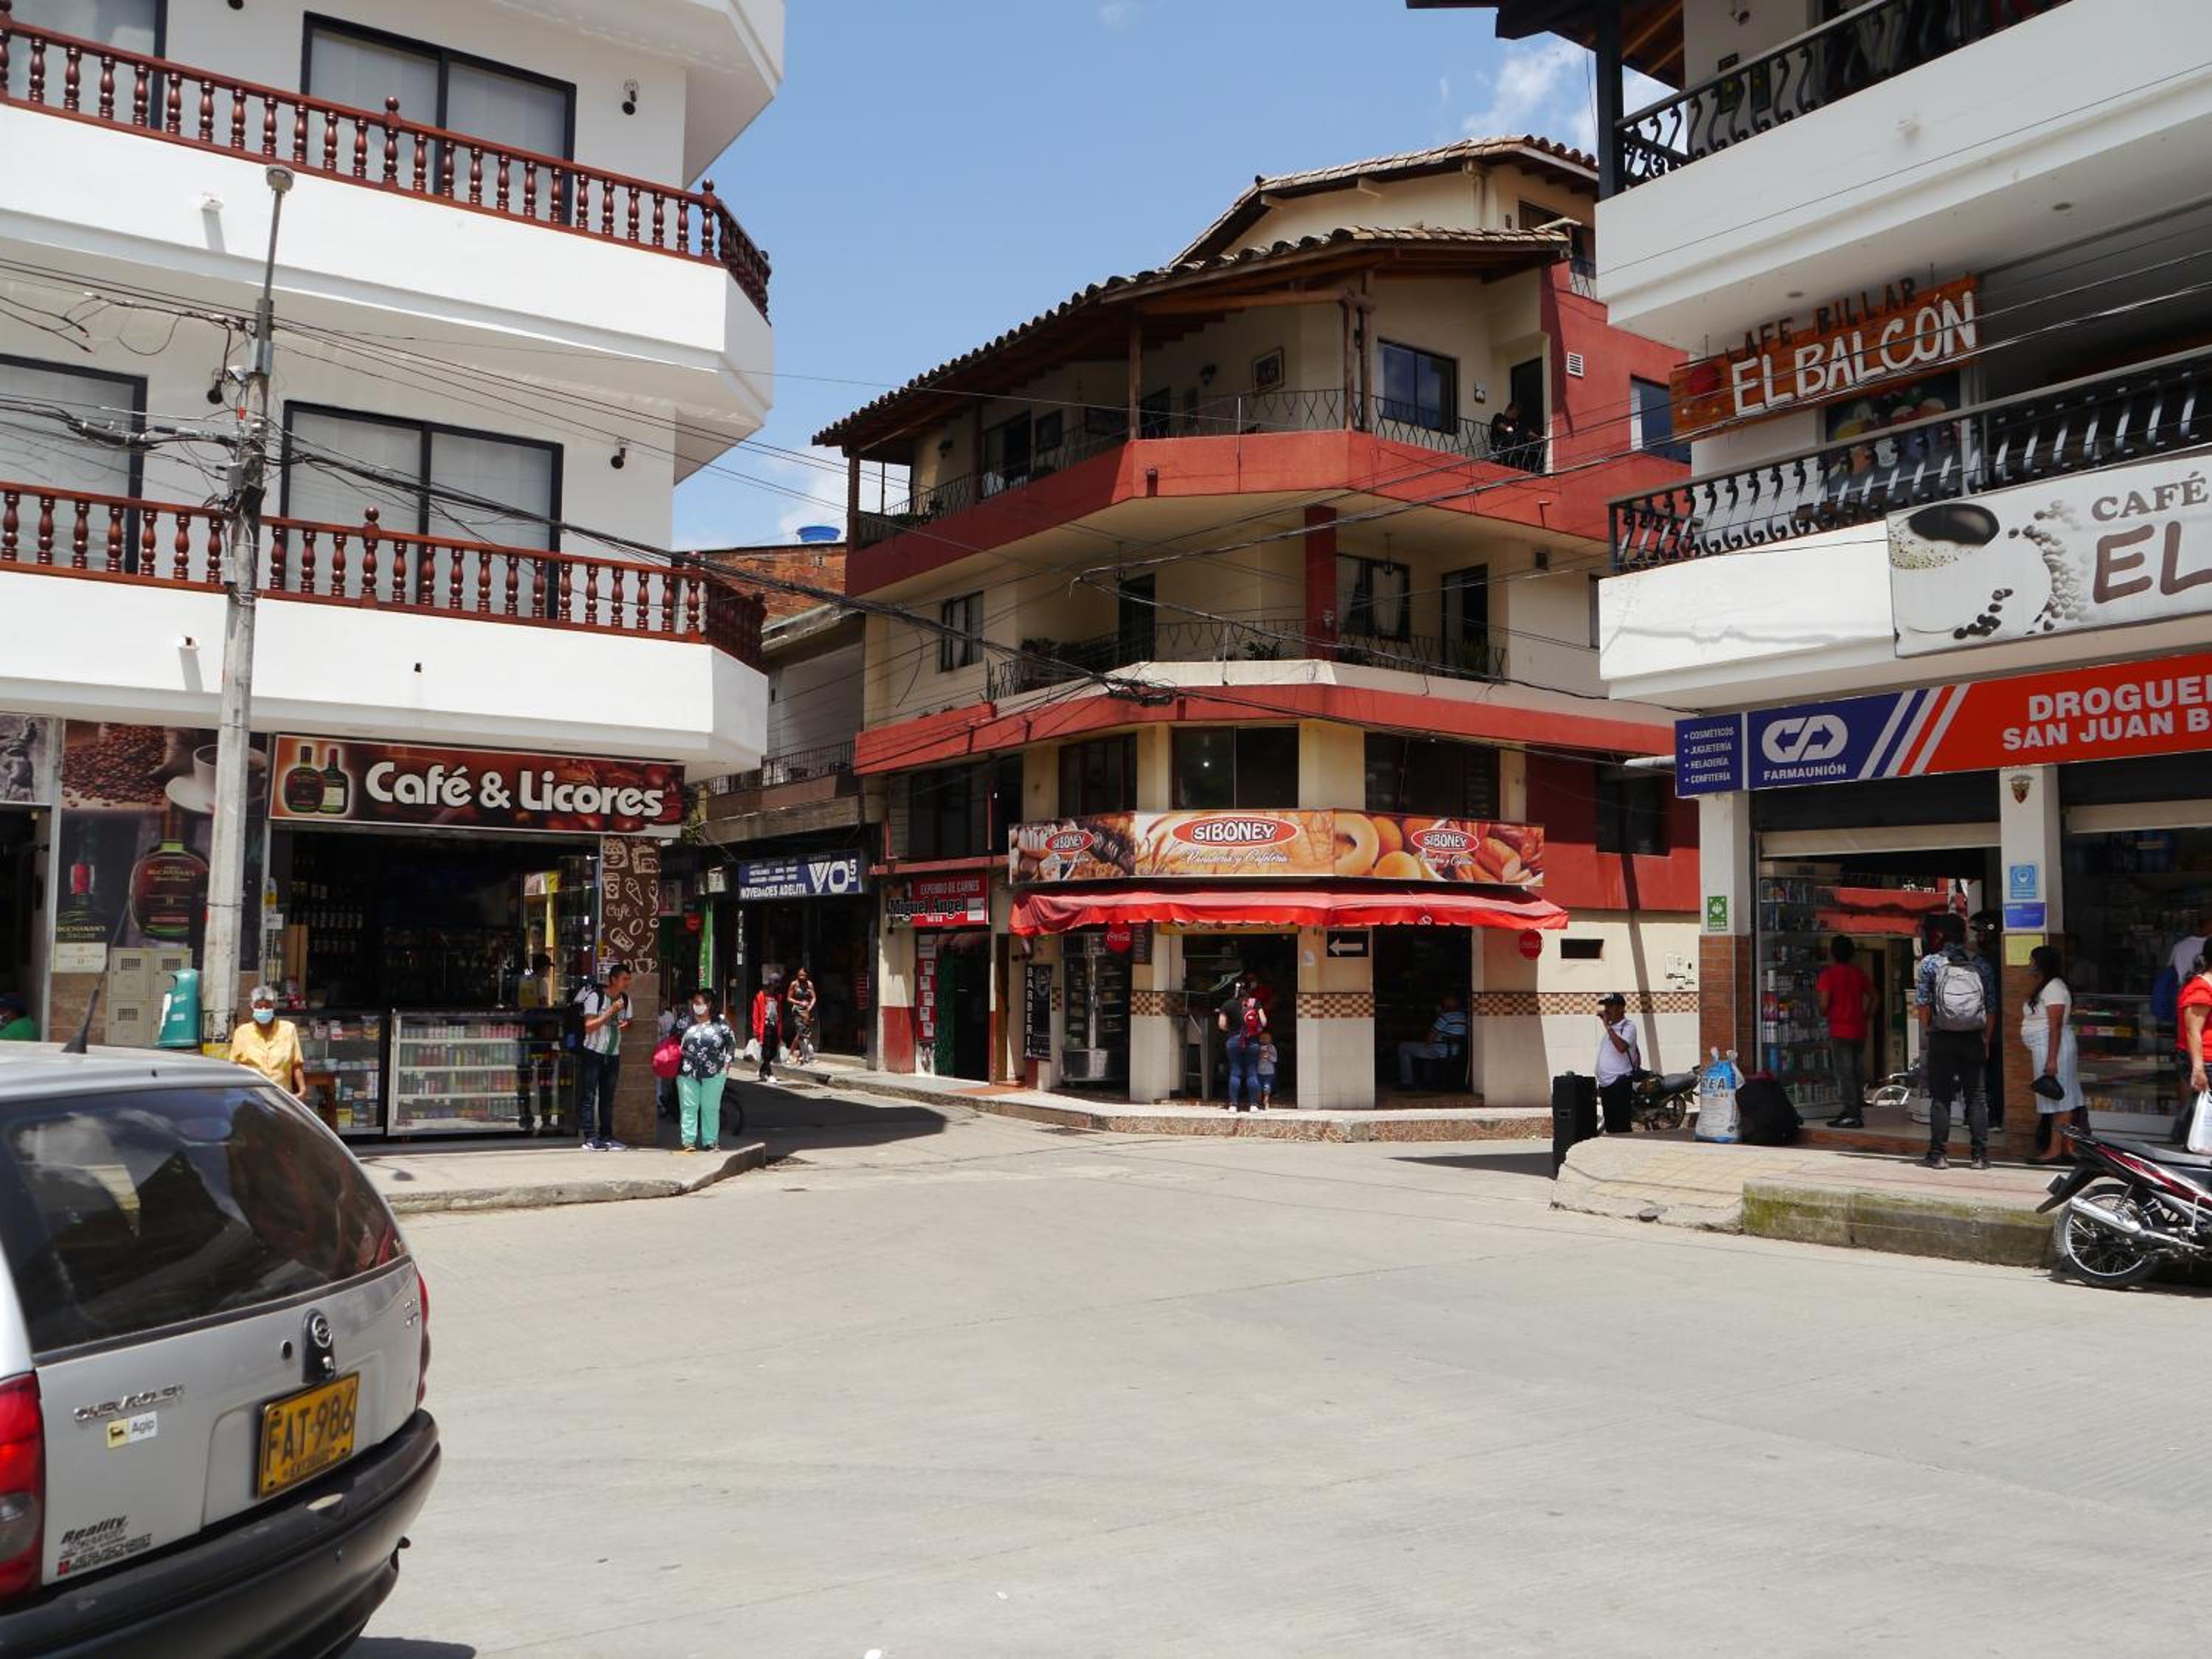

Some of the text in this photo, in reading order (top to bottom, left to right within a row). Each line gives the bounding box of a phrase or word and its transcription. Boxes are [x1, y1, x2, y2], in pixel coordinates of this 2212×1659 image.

[1731, 291, 1977, 417] EL BALCÓN
[2091, 471, 2209, 521] CAFÉ
[2093, 521, 2212, 604] EL
[2028, 675, 2212, 722] DROGUE
[2003, 722, 2068, 751] SAN
[2079, 711, 2174, 742] JUAN
[366, 762, 664, 817] Café & Licores
[1764, 762, 1846, 781] FARMAUNIÓN
[1192, 821, 1276, 843] SIBONEY
[1423, 833, 1467, 848] SIBONEY
[740, 883, 807, 899] NOVEDADES ADELITA
[61, 1515, 127, 1545] Reality
